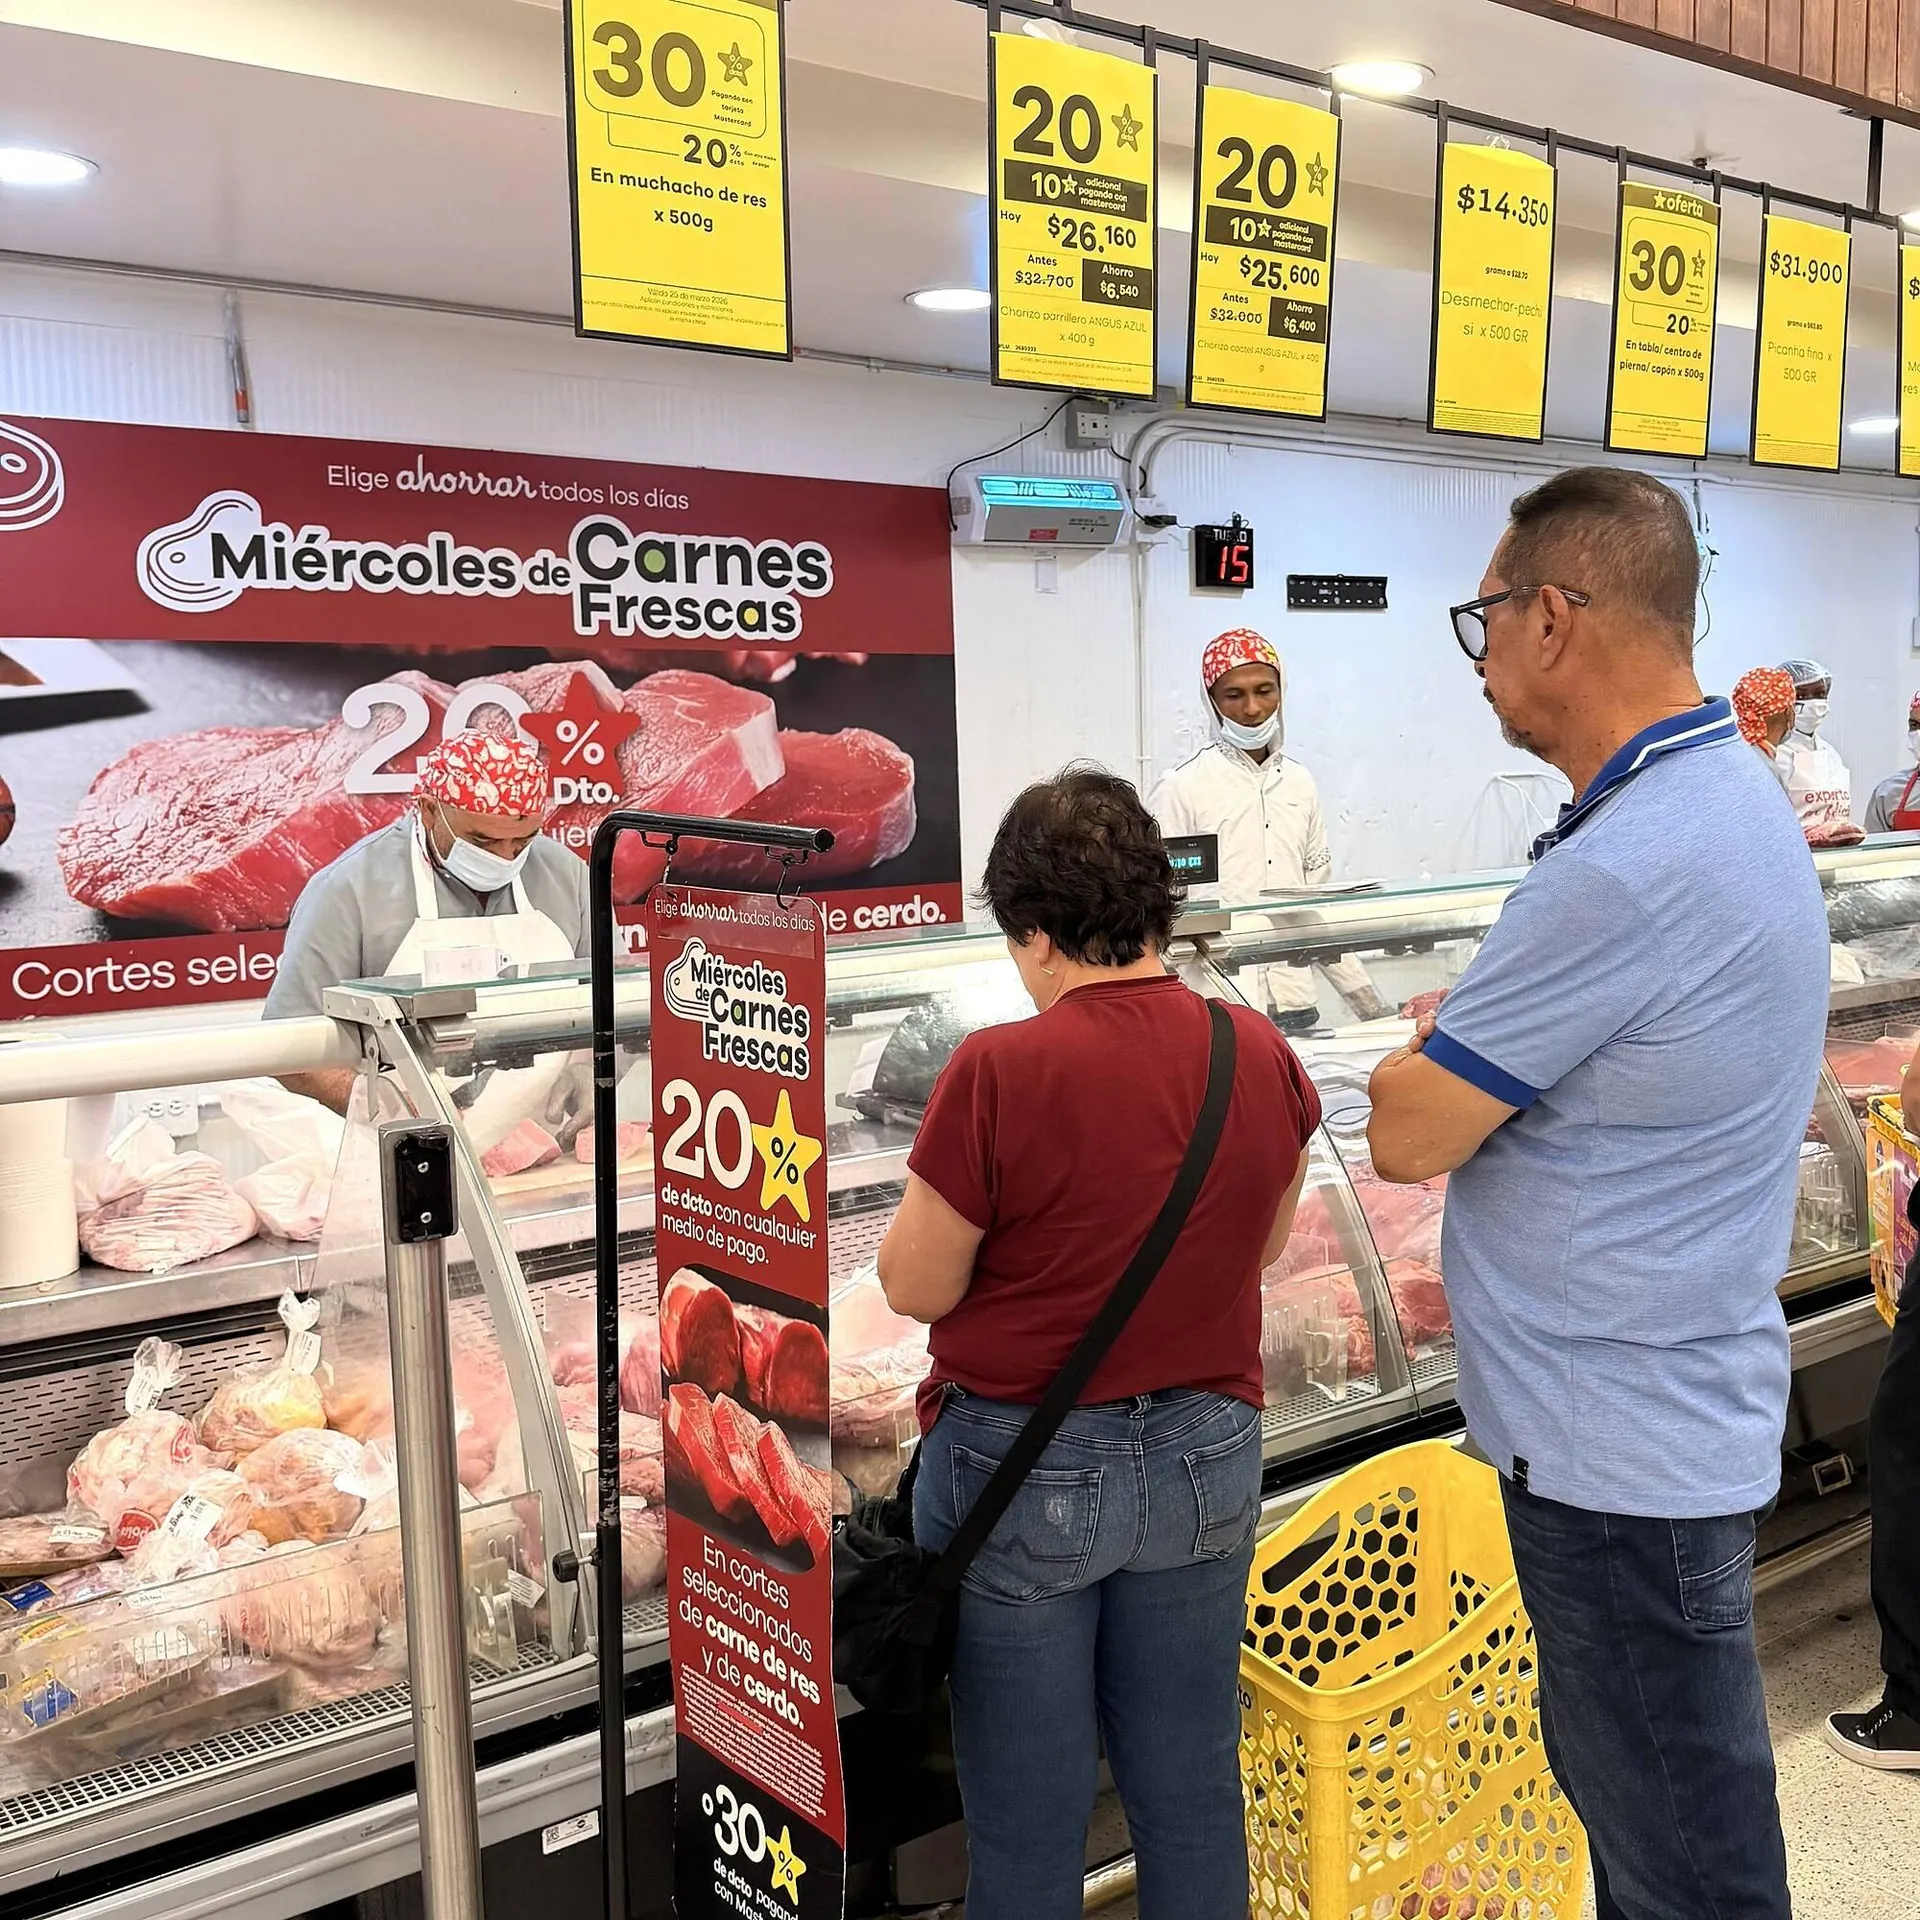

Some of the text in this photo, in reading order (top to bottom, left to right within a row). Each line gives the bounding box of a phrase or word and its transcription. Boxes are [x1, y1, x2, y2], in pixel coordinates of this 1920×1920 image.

[593, 21, 706, 107] 30
[714, 114, 752, 127] Mastercard
[721, 104, 744, 114] tarjeta
[1012, 85, 1101, 164] 20
[683, 134, 742, 168] 20 %
[1031, 172, 1061, 200] 10
[1085, 177, 1122, 192] adicional
[1216, 137, 1297, 209] 20
[590, 167, 767, 208] En muchacho de res
[1078, 187, 1128, 203] pagando con
[1000, 210, 1021, 223] Hoy
[1080, 197, 1126, 212] mastercard
[1457, 184, 1549, 227] $14.350
[1667, 195, 1703, 218] oferta
[654, 209, 713, 233] x 500g
[1048, 213, 1136, 253] $26.160
[1230, 216, 1257, 242] 10
[1279, 222, 1309, 234] adicional
[1272, 230, 1314, 245] pagando con
[1274, 240, 1311, 253] mastercard
[1027, 254, 1057, 266] Antes
[1102, 264, 1134, 278] Ahorro
[1200, 251, 1219, 264] Hoy
[1485, 266, 1506, 276] gramo
[1629, 240, 1686, 296] 30
[1770, 250, 1842, 284] $31.900
[1015, 270, 1074, 288] $32.700
[1240, 254, 1320, 291] $25.600
[1100, 280, 1139, 299] $6.540
[1222, 292, 1249, 304] Antes
[1210, 307, 1263, 324] $32.000
[1286, 301, 1313, 314] Ahorro
[1442, 291, 1542, 317] Desmechar-pechi
[1000, 305, 1148, 333] Chorizo parrillero ANGUS AZUL
[1284, 316, 1316, 334] $6.400
[1463, 322, 1528, 343] si x 500 GR
[1666, 313, 1689, 335] 20
[1059, 332, 1095, 347] x 400 g
[1197, 340, 1229, 351] Chorizo
[1254, 347, 1282, 358] ANGUS
[1626, 340, 1637, 350] En
[1664, 346, 1691, 358] centro
[1692, 349, 1702, 359] de
[1768, 341, 1833, 362] Picanha fina x
[1620, 359, 1651, 373] pierna/
[1678, 369, 1683, 377] x
[1684, 368, 1704, 382] 500g
[1783, 368, 1817, 383] 500 GR
[327, 454, 690, 510] Elige ahorrar todos los días
[210, 522, 830, 590] Miércoles de Carnes
[1220, 545, 1250, 582] 15
[581, 584, 797, 635] Frescas
[556, 719, 605, 766] %
[553, 777, 620, 805] Dto.
[655, 890, 815, 931] Elige ahorrar todos los días
[12, 957, 176, 1000] Cortes
[187, 944, 284, 986] sele
[854, 894, 947, 928] cerdo.
[691, 956, 784, 996] Miércoles
[696, 985, 807, 1038] de Carnes
[705, 1023, 807, 1076] Frescas
[661, 1078, 799, 1190] 20 %
[661, 1182, 817, 1249] de dcto con cualquier
[662, 1213, 769, 1265] medio de pago.
[703, 1535, 789, 1610] En cortes
[683, 1566, 813, 1663] seleccionados
[679, 1595, 821, 1704] de carne de res
[702, 1646, 713, 1674] y
[717, 1652, 741, 1687] de
[744, 1673, 804, 1730] cerdo.
[702, 1784, 793, 1881] o 30 %
[713, 1857, 727, 1878] de
[728, 1868, 752, 1898] dcto
[714, 1881, 733, 1906] con
